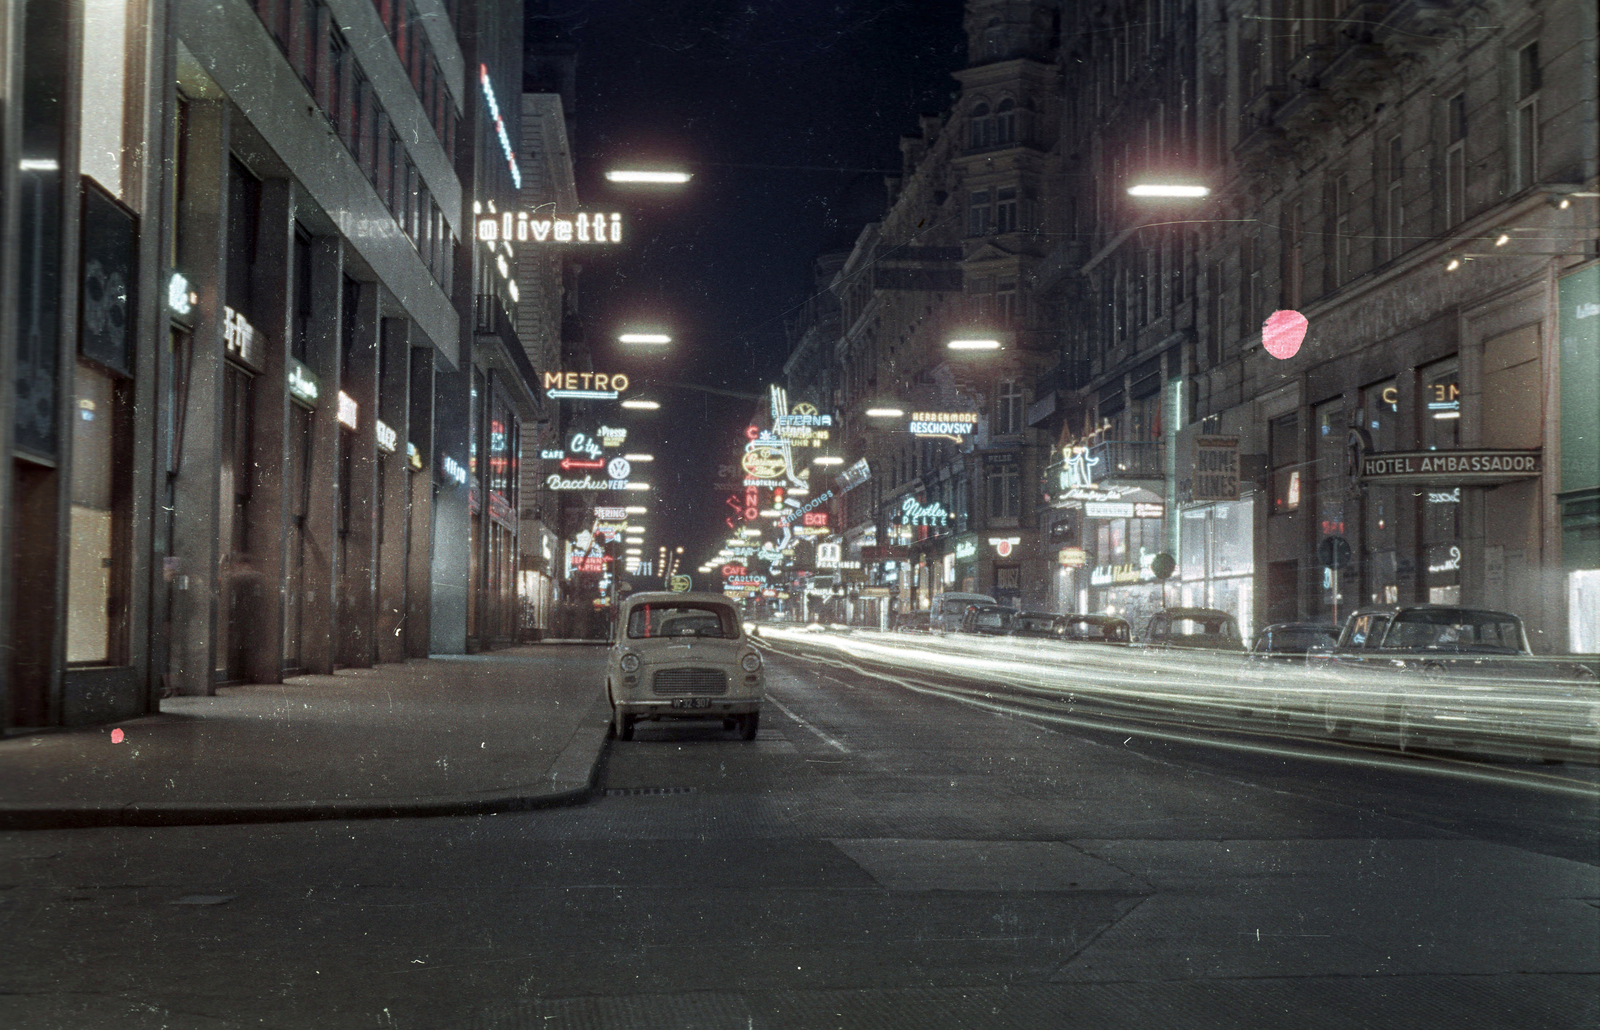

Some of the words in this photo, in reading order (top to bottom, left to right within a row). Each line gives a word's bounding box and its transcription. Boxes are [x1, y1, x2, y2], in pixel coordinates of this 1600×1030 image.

[478, 211, 622, 242] olivetti
[544, 372, 629, 391] METRO
[779, 414, 832, 426] ETERNA
[910, 422, 973, 433] RESCHOVSKY
[570, 432, 602, 460] Cty
[790, 439, 821, 448] UHRN
[1366, 458, 1414, 475] HOTEL
[1421, 456, 1535, 472] AMBASSADOR
[547, 474, 608, 490] Bacchus
[902, 515, 947, 526] PELZE
[722, 564, 747, 576] CAFE
[728, 575, 767, 583] CARLTON
